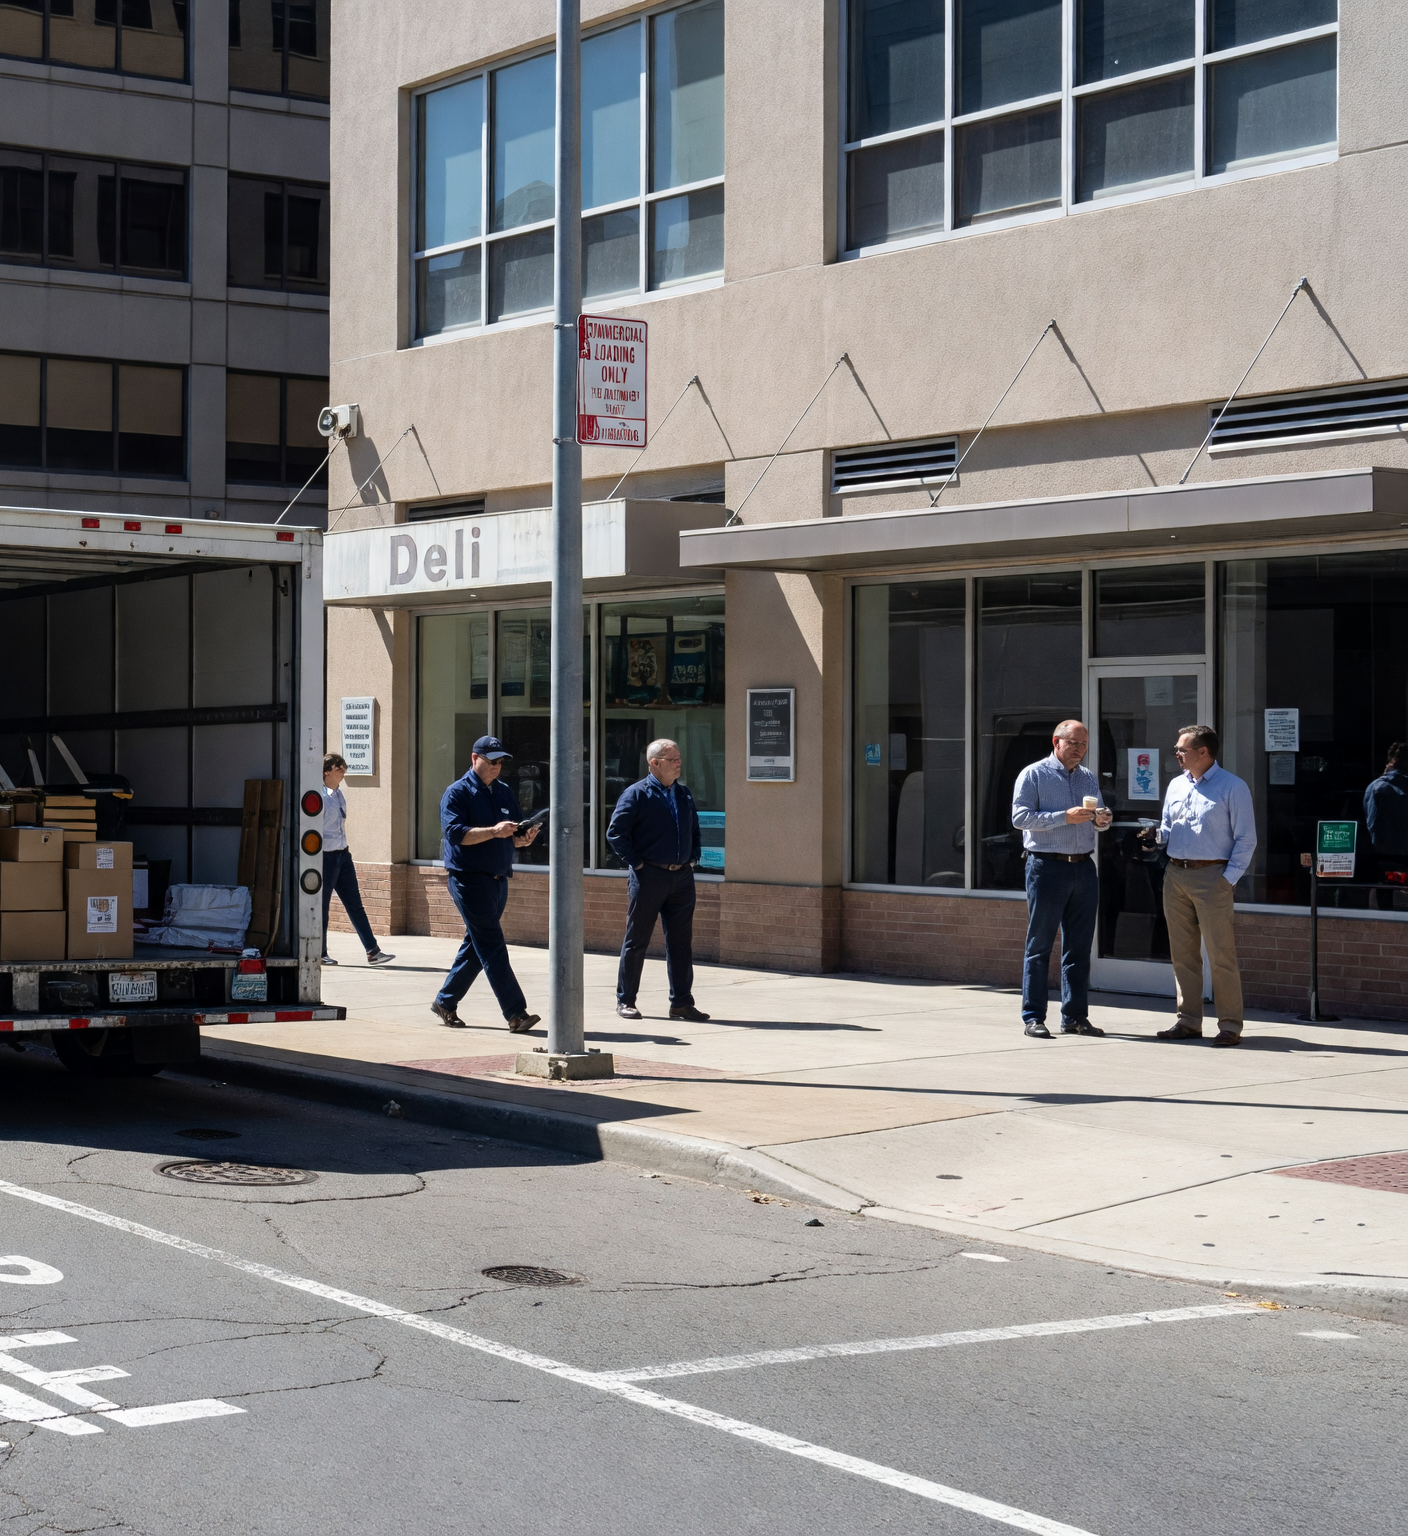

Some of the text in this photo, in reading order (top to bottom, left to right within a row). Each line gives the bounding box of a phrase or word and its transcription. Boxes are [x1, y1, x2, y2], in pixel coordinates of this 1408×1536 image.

[594, 343, 635, 364] LOADING
[601, 365, 628, 384] ONLY
[389, 526, 481, 586] Deli
